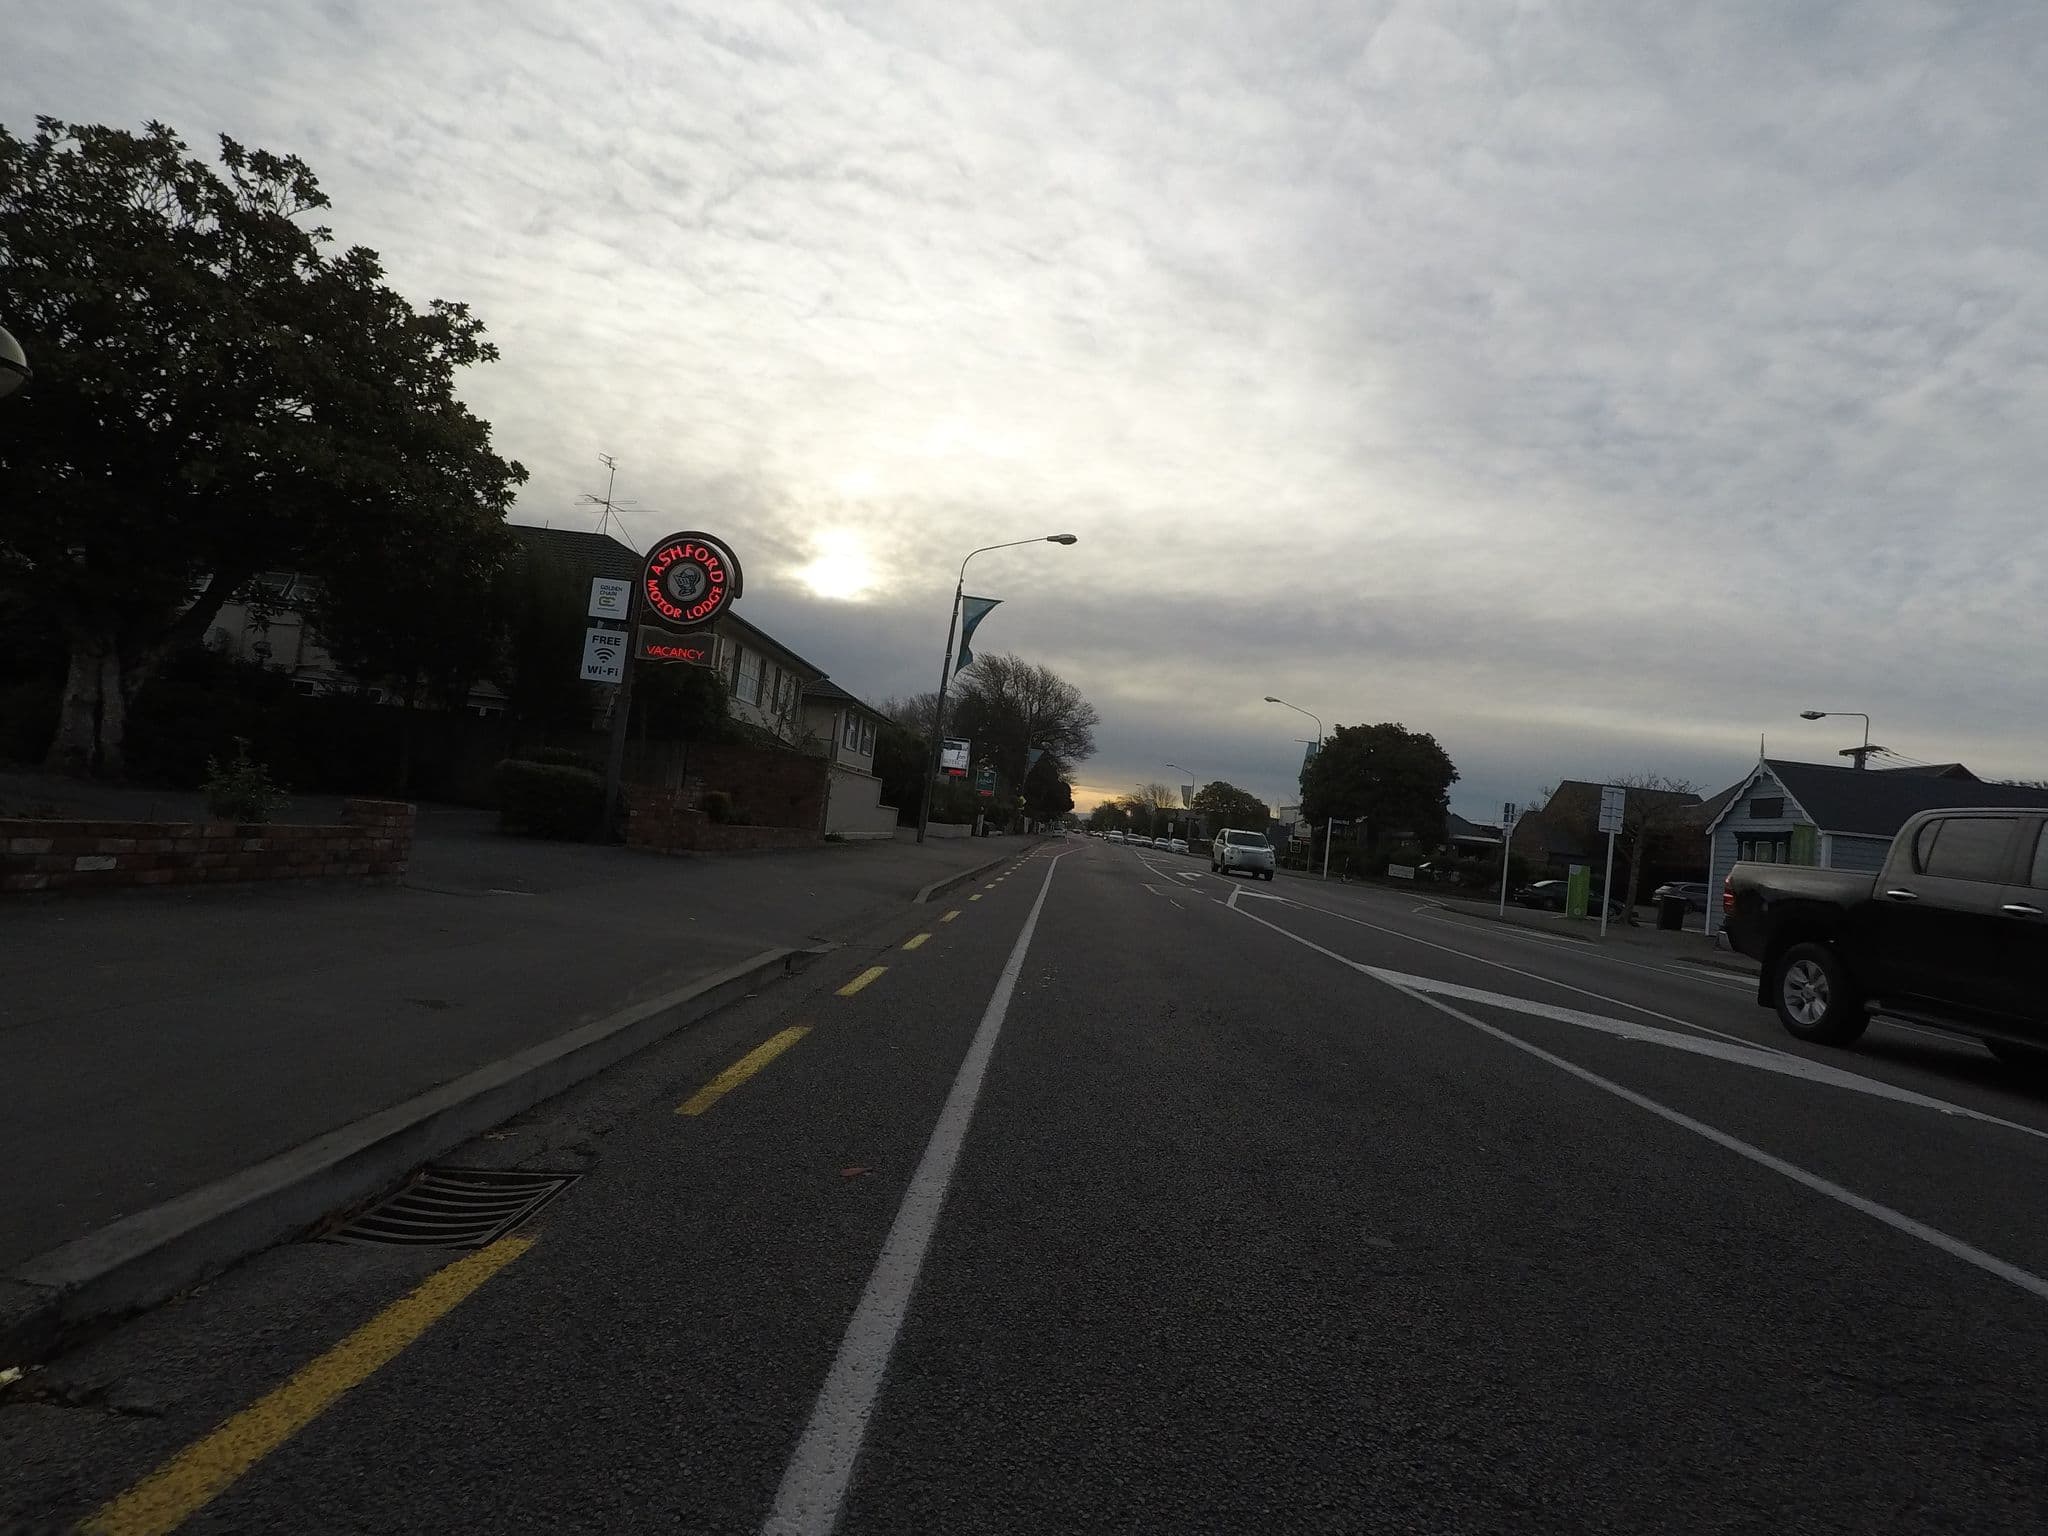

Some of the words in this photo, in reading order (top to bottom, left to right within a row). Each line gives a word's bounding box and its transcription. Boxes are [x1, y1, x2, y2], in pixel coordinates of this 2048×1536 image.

[650, 543, 724, 583] ASHFORD
[647, 579, 682, 618] MOTOR
[686, 586, 723, 619] LODGE
[592, 635, 621, 646] FREE
[646, 645, 704, 659] VACANCY
[587, 665, 618, 676] Wi-Fi
